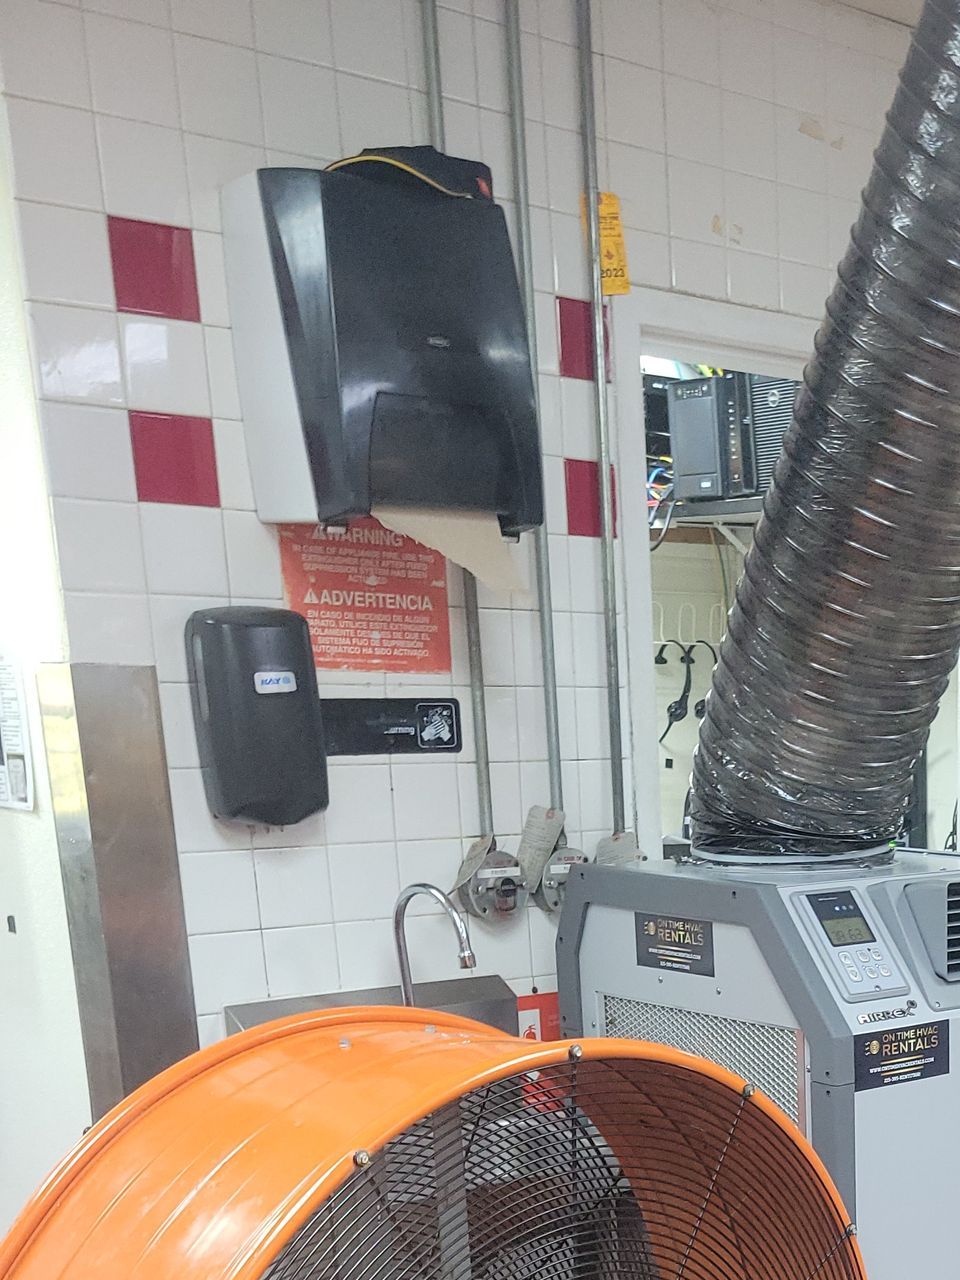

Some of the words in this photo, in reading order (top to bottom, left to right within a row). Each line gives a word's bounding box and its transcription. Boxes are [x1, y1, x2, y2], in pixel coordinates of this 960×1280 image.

[600, 268, 625, 278] 2023
[320, 589, 433, 611] ADVERTENCIA
[320, 611, 342, 619] CASO
[393, 614, 403, 622] DE
[340, 621, 367, 629] UTILICE
[369, 622, 387, 630] ESTE
[318, 637, 350, 645] SISTEMA
[352, 638, 367, 646] FIJO
[405, 632, 419, 640] QUE
[375, 647, 392, 655] SIDO
[657, 919, 667, 928] ON
[668, 920, 684, 930] TIME
[685, 922, 704, 933] HVAC
[657, 929, 704, 946] RENTALS
[857, 1000, 918, 1024] AIRREX
[882, 1033, 895, 1043] ON
[896, 1029, 916, 1040] TIME
[916, 1025, 939, 1037] HVAC
[882, 1035, 939, 1056] RENTALS
